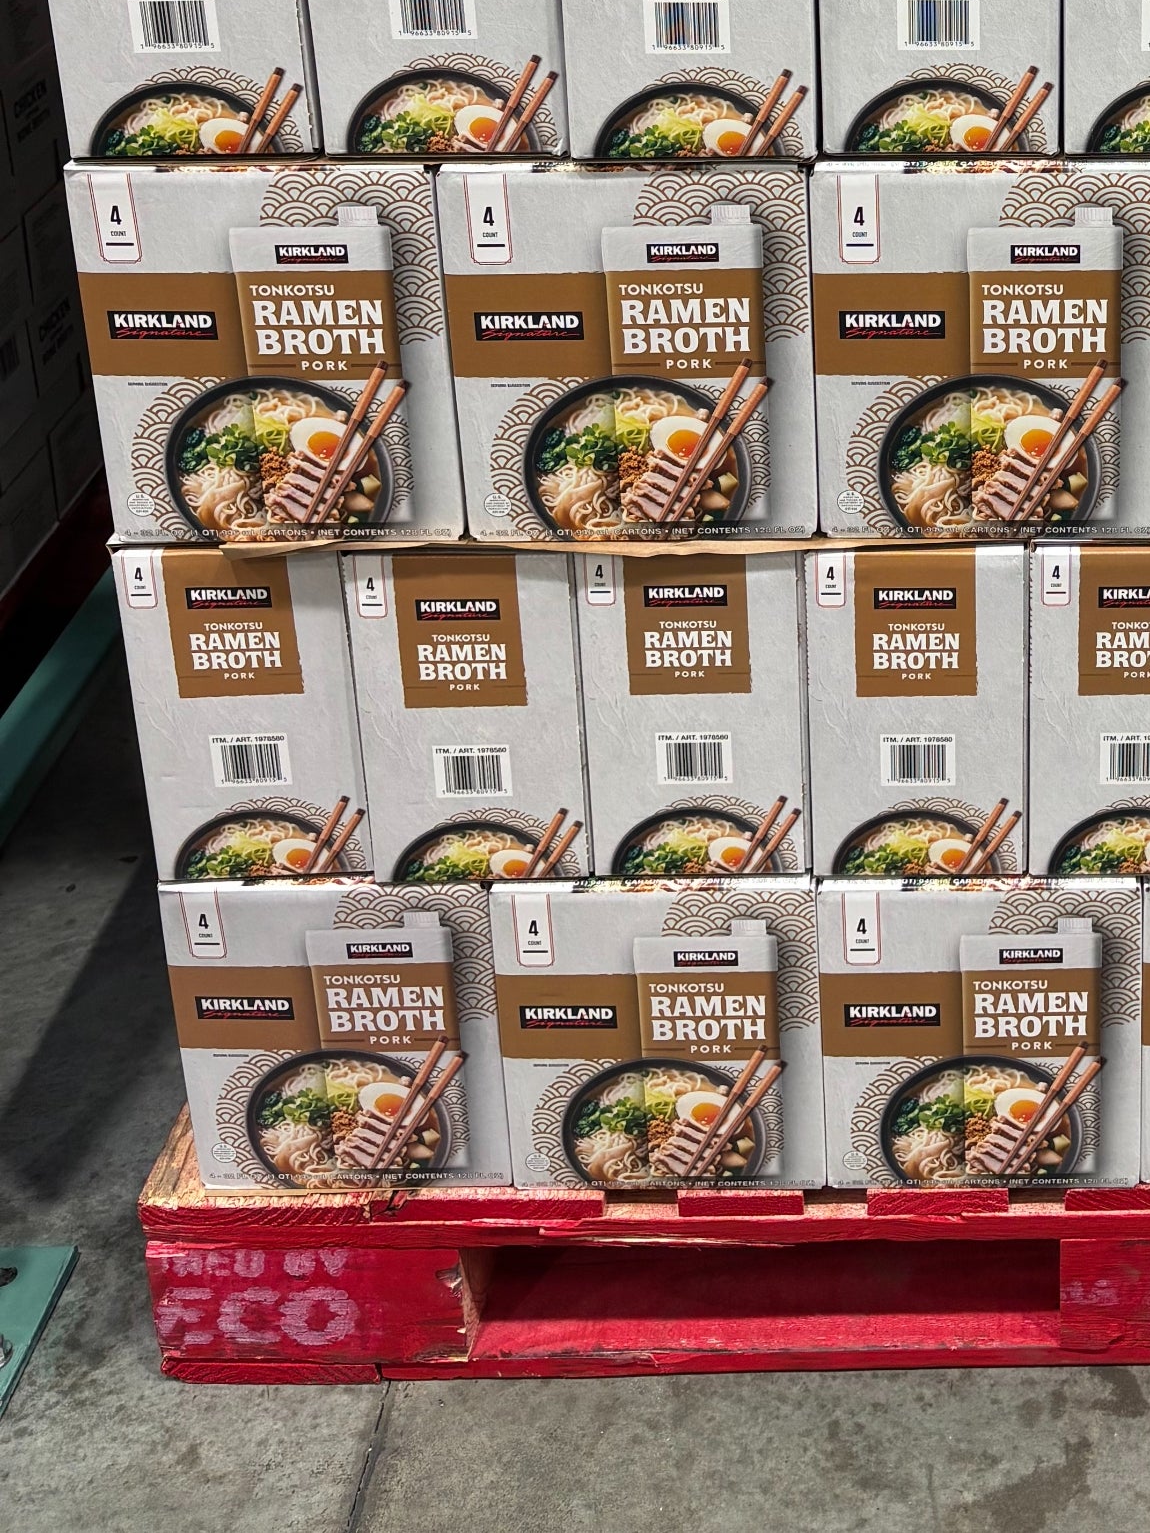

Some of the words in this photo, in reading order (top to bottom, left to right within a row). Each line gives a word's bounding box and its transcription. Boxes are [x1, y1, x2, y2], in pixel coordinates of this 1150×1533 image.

[111, 206, 121, 225] 4
[279, 247, 345, 256] KIRKLAND
[250, 285, 334, 296] TONKOTSU
[252, 300, 383, 325] RAMEN
[114, 314, 212, 328] KIRKLAND
[116, 327, 214, 339] Signature
[256, 329, 385, 354] BROTH
[302, 361, 347, 370] PORK
[421, 602, 496, 612] KIRKLAND
[432, 634, 489, 642] TONKOTSU
[417, 644, 506, 661] RAMEN
[419, 663, 507, 680] BROTH
[199, 914, 209, 929] 4
[324, 975, 400, 985] TONKOTSU
[201, 996, 289, 1010] KIRKLAND
[326, 987, 443, 1008] RAMEN
[329, 1010, 445, 1032] BROTH
[370, 1036, 411, 1044] PORK
